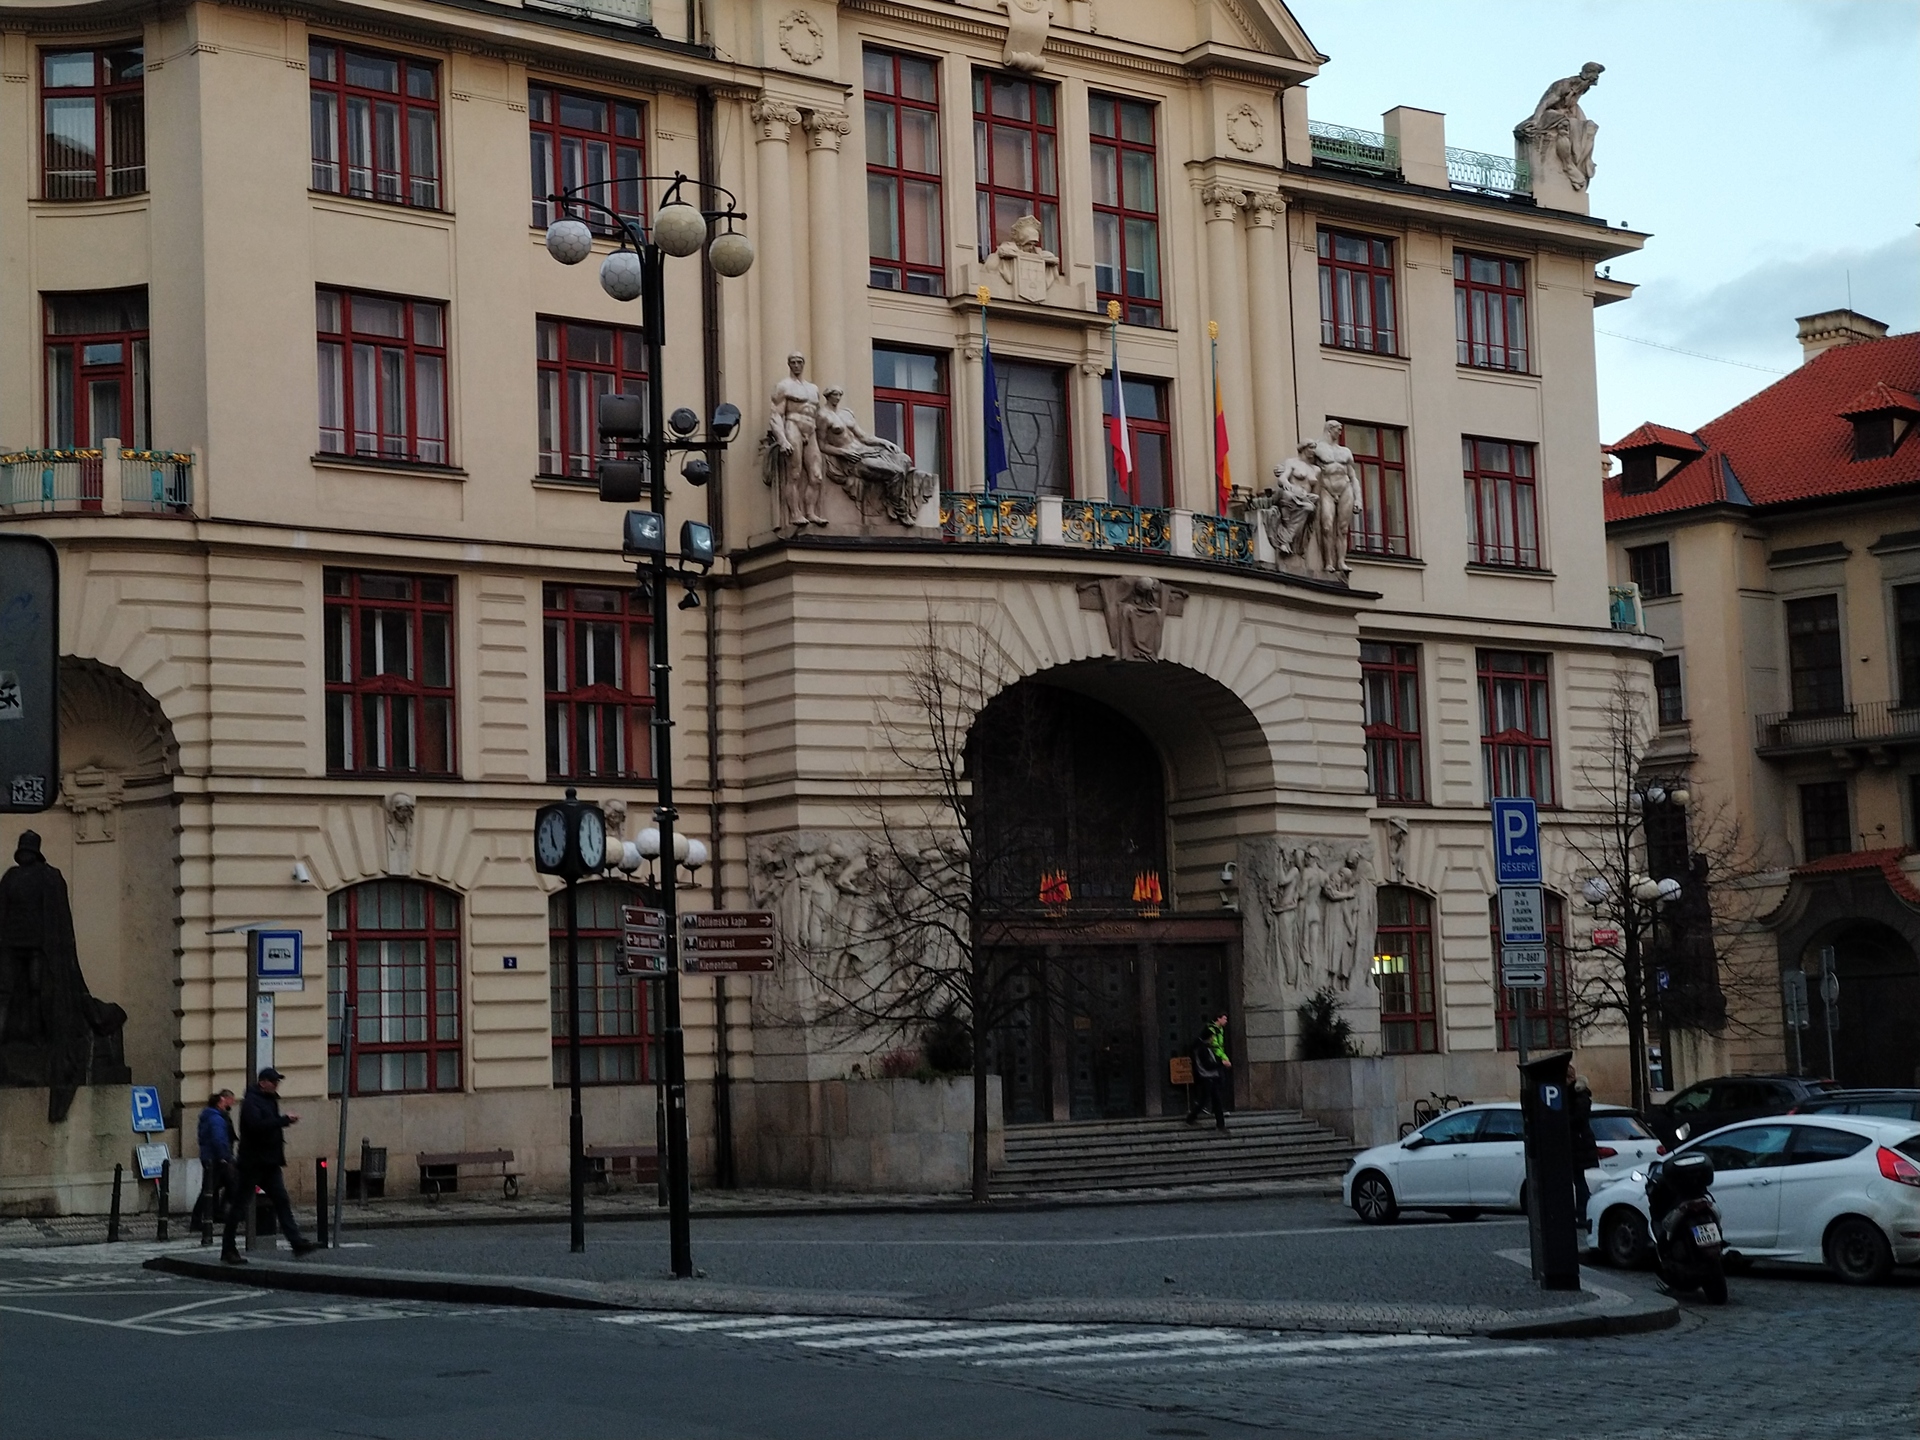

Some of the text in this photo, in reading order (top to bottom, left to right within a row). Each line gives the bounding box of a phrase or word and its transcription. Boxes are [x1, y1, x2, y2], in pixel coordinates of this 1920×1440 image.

[12, 790, 44, 802] NZS
[1503, 809, 1528, 856] P
[1501, 860, 1537, 873] RÉSERVÉ
[731, 916, 747, 928] kaple
[720, 938, 736, 948] most
[1545, 1085, 1559, 1106] P
[134, 1092, 152, 1117] P
